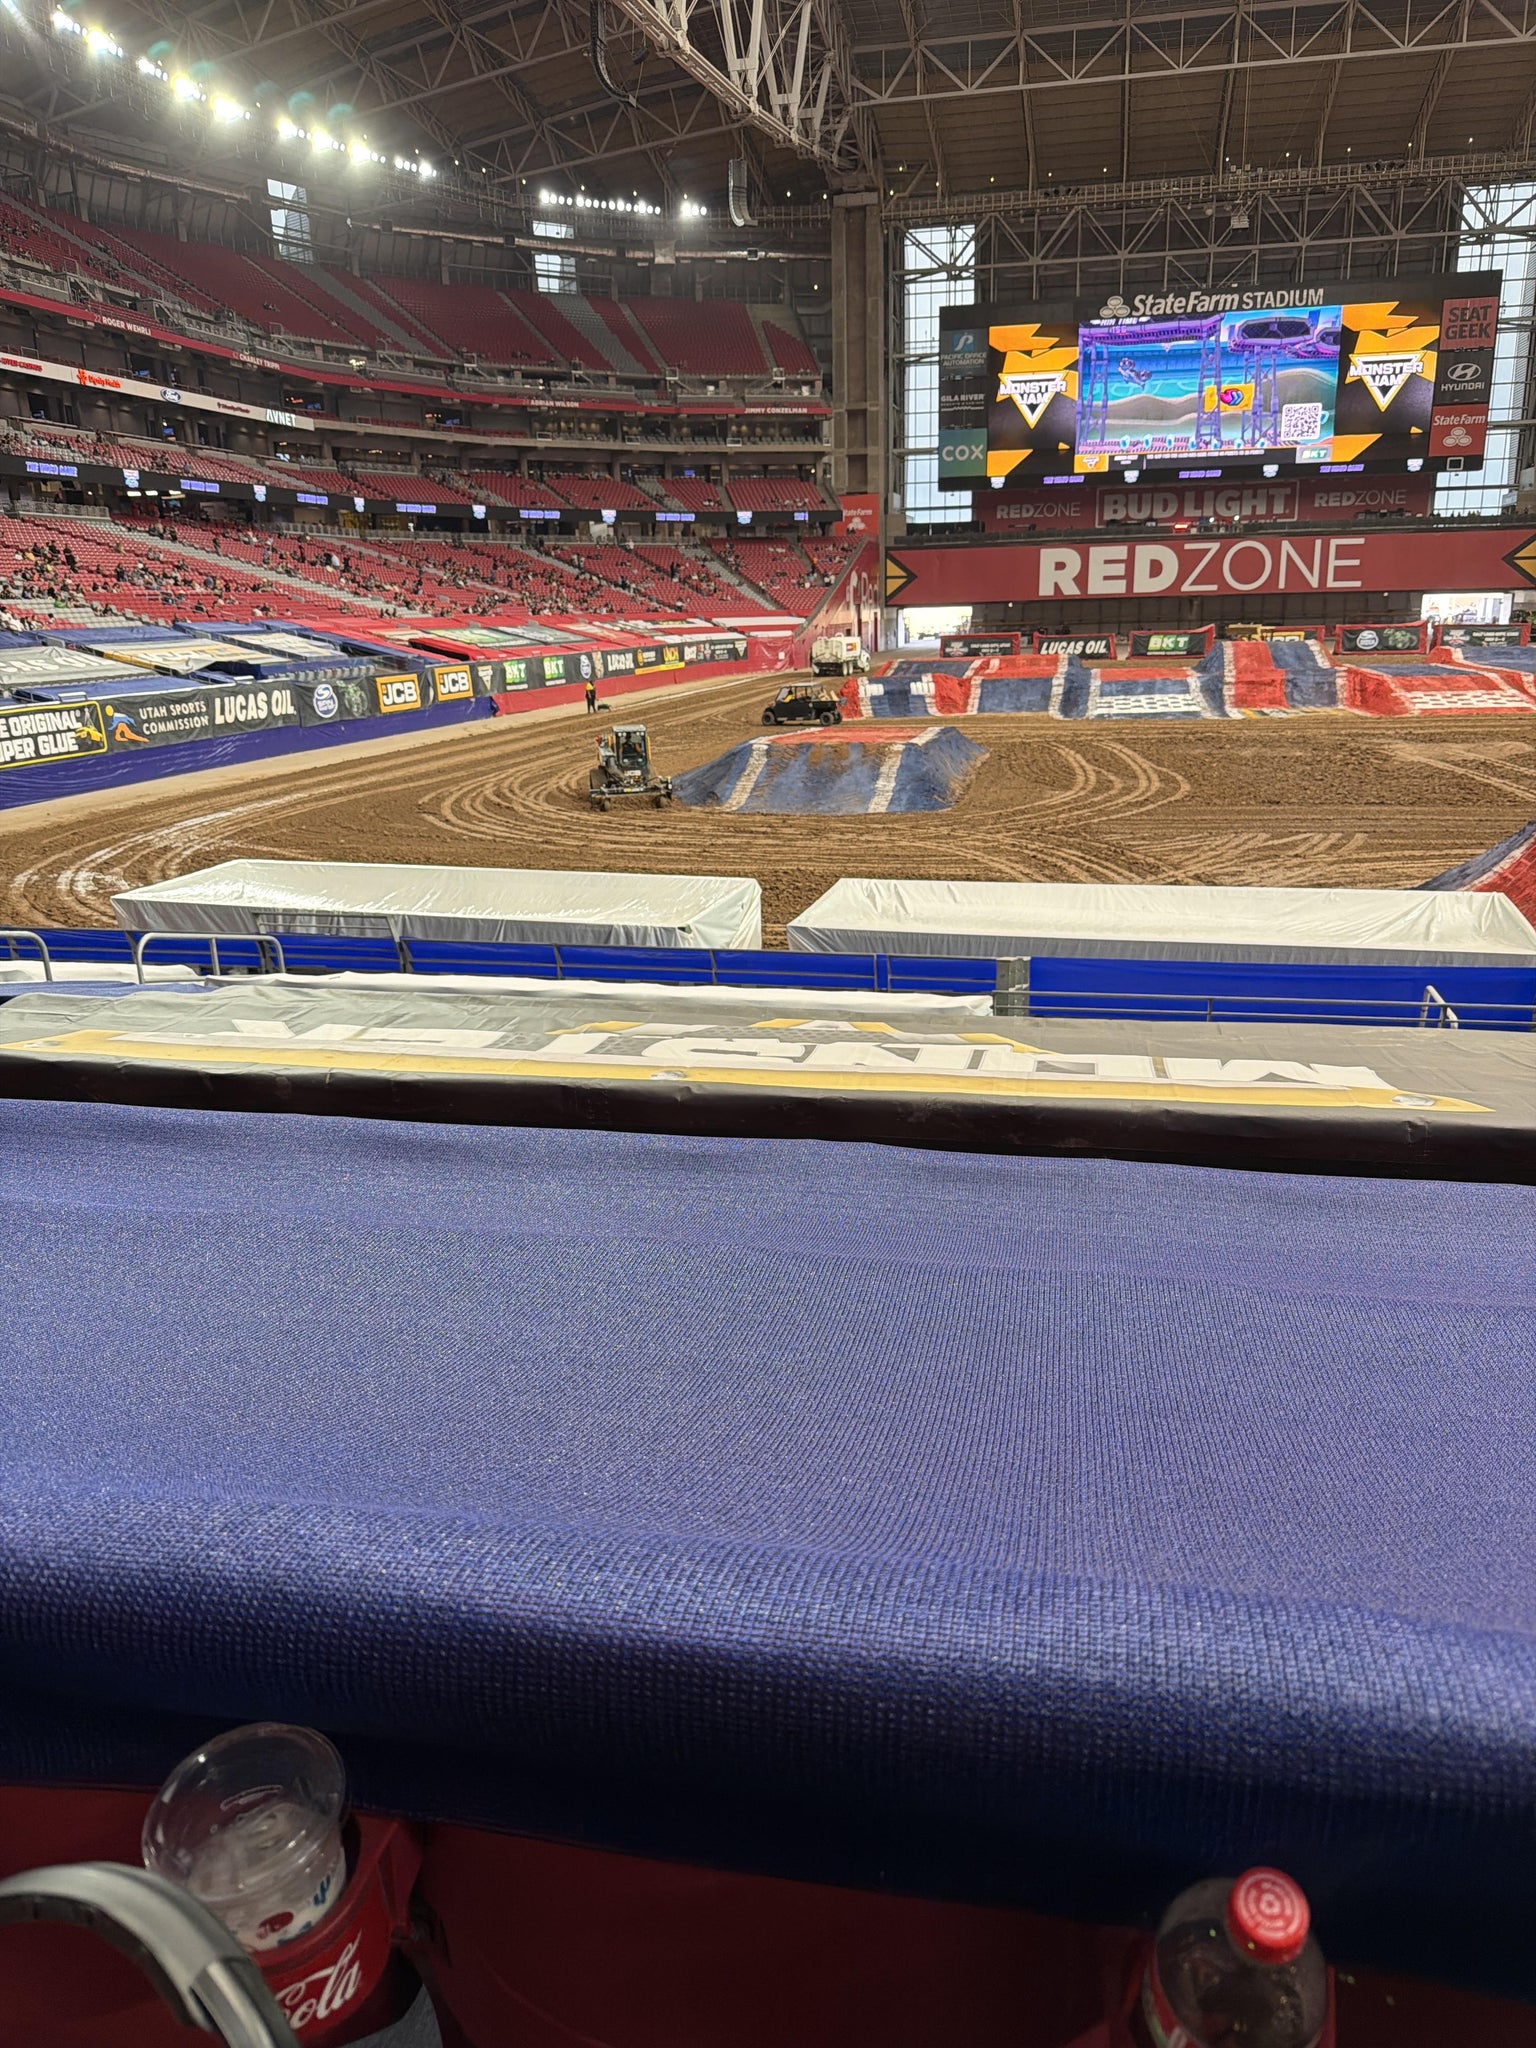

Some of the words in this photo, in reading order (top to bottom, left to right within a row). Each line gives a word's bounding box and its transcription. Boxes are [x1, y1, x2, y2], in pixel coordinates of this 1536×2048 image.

[1242, 288, 1324, 310] STADIUM
[1449, 305, 1492, 322] SEAT
[102, 316, 126, 329] ROGER
[126, 322, 152, 336] WEHRLI
[1445, 323, 1491, 340] GEEK
[1350, 362, 1424, 376] MONSTER
[1000, 381, 1067, 395] MONSTER
[1367, 374, 1403, 386] JAM
[1441, 382, 1485, 391] HYUNDAI
[1017, 393, 1050, 404] JAM
[266, 409, 297, 428] AVNET
[942, 445, 984, 461] COX
[1302, 450, 1327, 459] BKT
[1103, 492, 1178, 520] BUD
[1184, 487, 1292, 518] LIGHT
[1314, 490, 1407, 508] REDZONE
[996, 502, 1081, 519] REDZONE
[1038, 538, 1366, 597] REDZONE
[1040, 640, 1084, 655] LUCAS
[1085, 640, 1108, 654] OIL
[1150, 636, 1190, 649] BKT
[505, 662, 526, 680] BKT
[544, 659, 564, 676] BKT
[440, 672, 470, 694] JCB
[382, 681, 417, 705] JCB
[139, 706, 167, 720] UTAH
[170, 701, 207, 716] SPORTS
[214, 691, 268, 725] LUCAS
[271, 689, 295, 717] OIL
[9, 710, 82, 737] ORIGINAL
[143, 715, 209, 735] COMMISSION
[37, 731, 79, 755] GLUE
